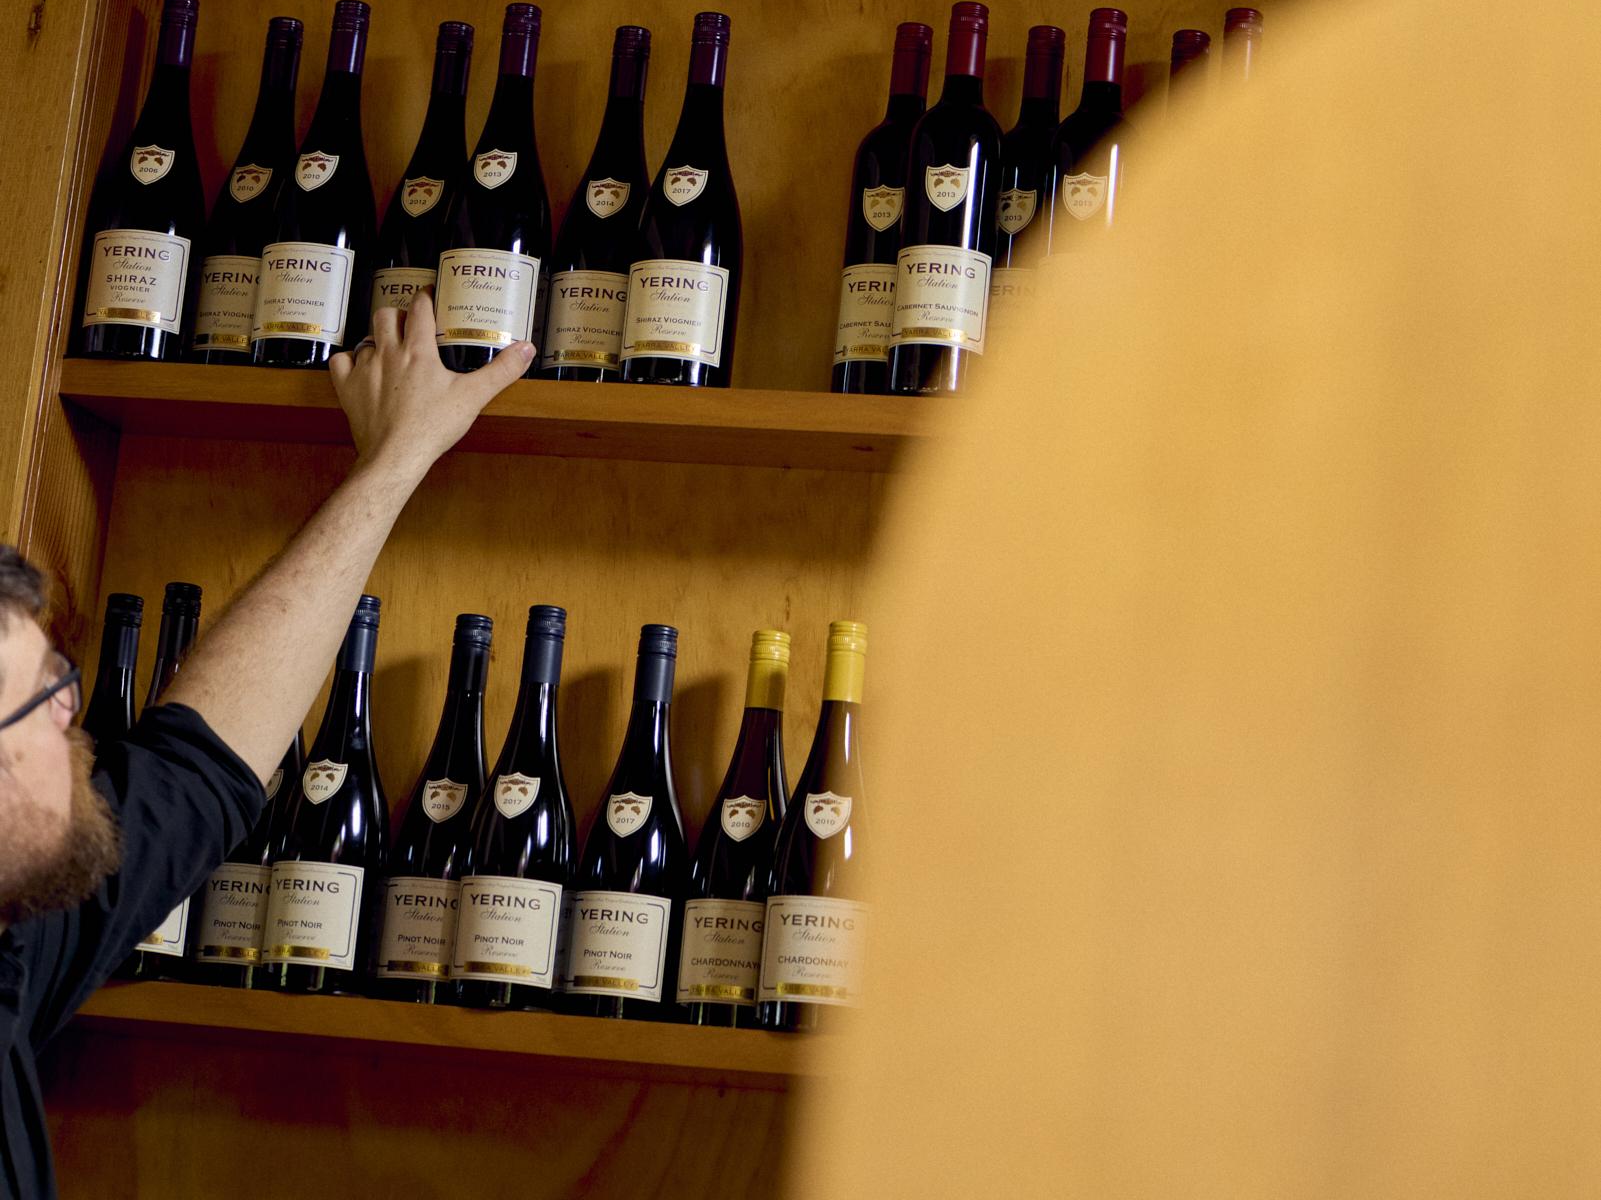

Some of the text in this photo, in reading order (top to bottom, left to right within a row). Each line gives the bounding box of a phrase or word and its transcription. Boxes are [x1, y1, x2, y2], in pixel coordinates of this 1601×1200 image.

[103, 245, 170, 260] YERING
[268, 258, 332, 272] YERING
[906, 262, 976, 279] YERING
[451, 265, 520, 280] YERING
[106, 274, 157, 286] SHIRAZ
[463, 278, 502, 292] Station
[640, 276, 709, 291] YERING
[848, 281, 895, 293] YERIN
[916, 274, 958, 289] Station
[110, 285, 150, 293] VIOGNIER
[560, 287, 628, 302] YERING
[650, 288, 691, 303] Station
[991, 285, 1036, 296] ERIN
[287, 298, 325, 307] VIOGNIER
[223, 311, 255, 320] VIOGNIE
[310, 784, 329, 792] 2014
[615, 817, 635, 825] 2017
[276, 879, 340, 894] YERING
[470, 894, 541, 910] YERING
[580, 909, 649, 924] YERING
[780, 914, 855, 931] YERING
[213, 920, 237, 928] PINOT
[277, 919, 322, 929] PINOT NOIR
[589, 922, 630, 937] Station
[694, 917, 763, 933] YERING
[398, 934, 422, 943] PINOT
[474, 935, 525, 946] PINOT NOIR
[583, 949, 632, 960] PINOT NOIR
[778, 955, 849, 969] CHARDONNAY
